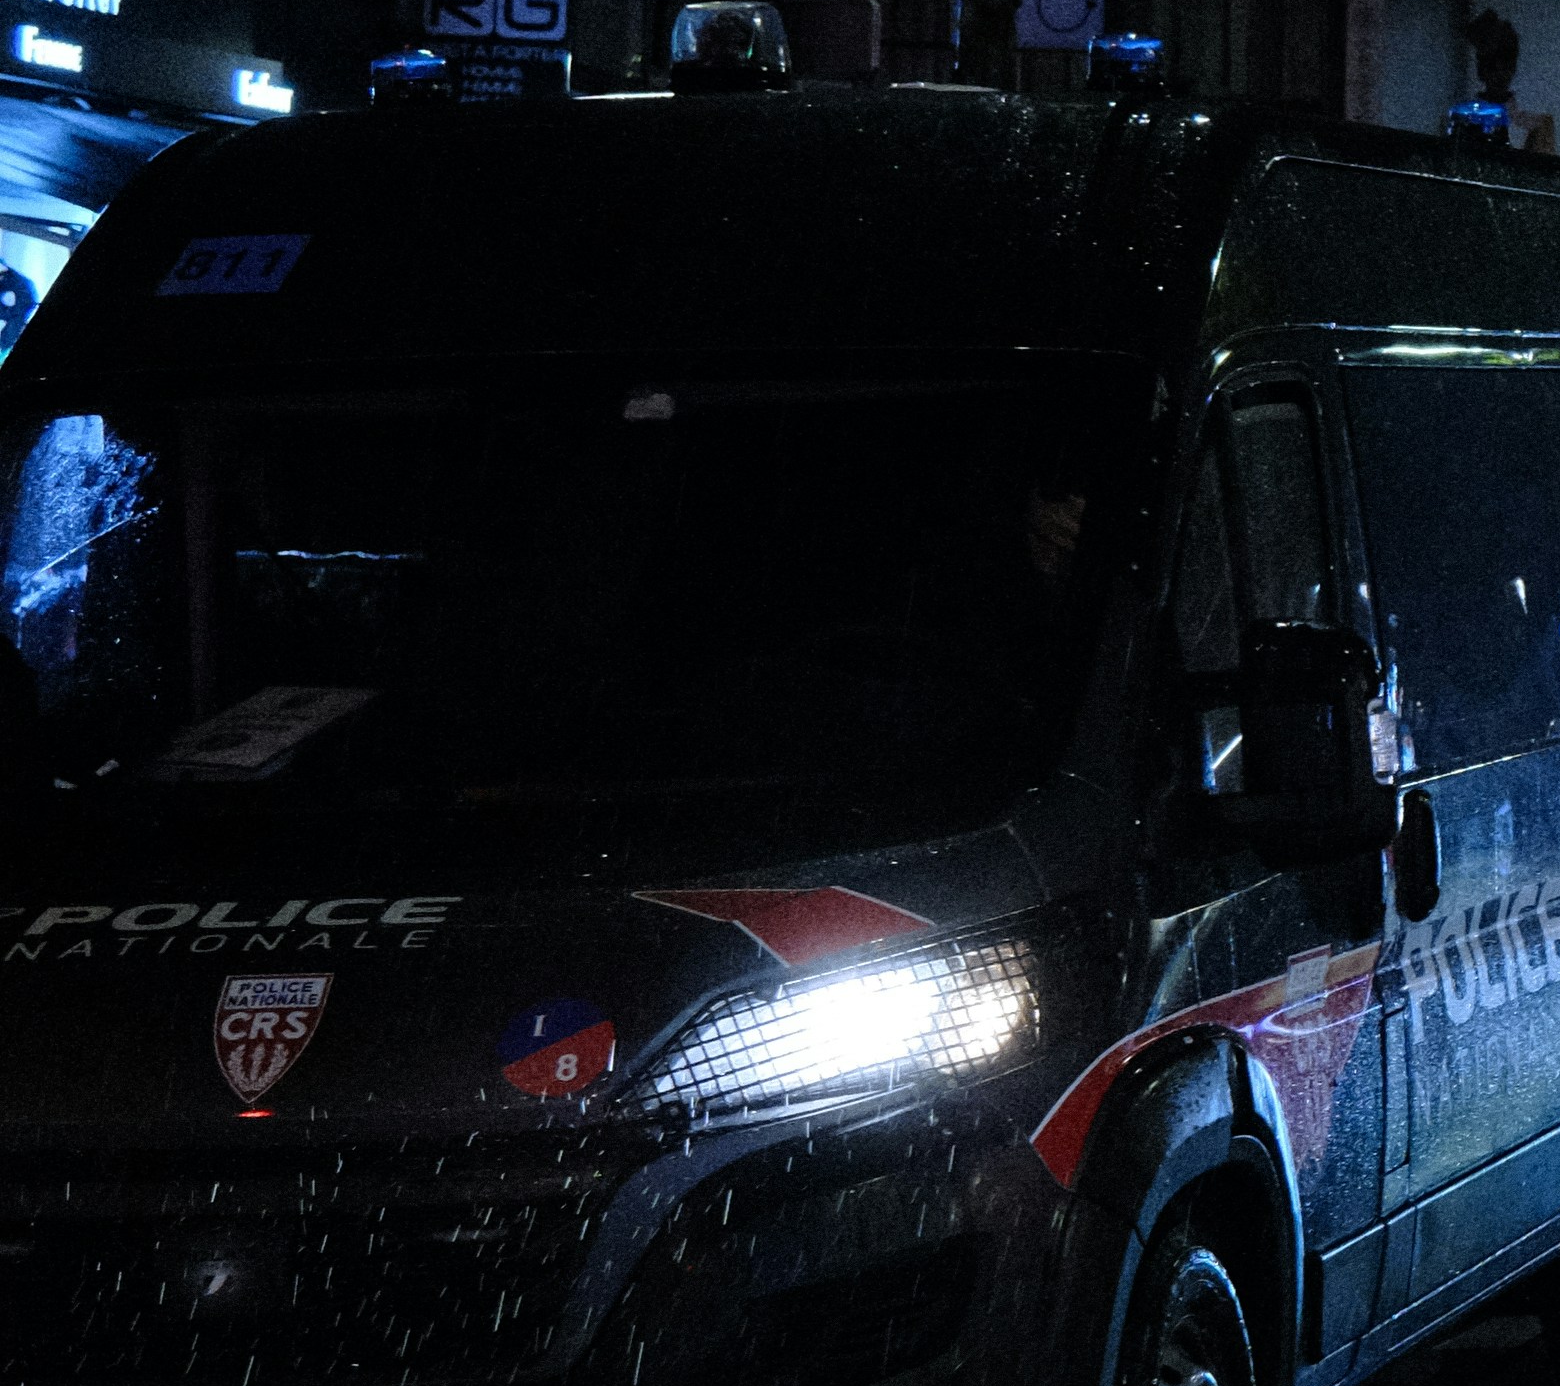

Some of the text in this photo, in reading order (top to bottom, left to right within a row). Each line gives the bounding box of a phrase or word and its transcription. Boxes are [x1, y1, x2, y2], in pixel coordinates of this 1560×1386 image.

[24, 895, 464, 937] POLICE
[3, 927, 436, 963] NATIONALE
[227, 994, 319, 1006] NATIONALE
[238, 981, 314, 994] POLICE
[220, 1011, 310, 1041] CRS
[555, 1053, 579, 1083] 8
